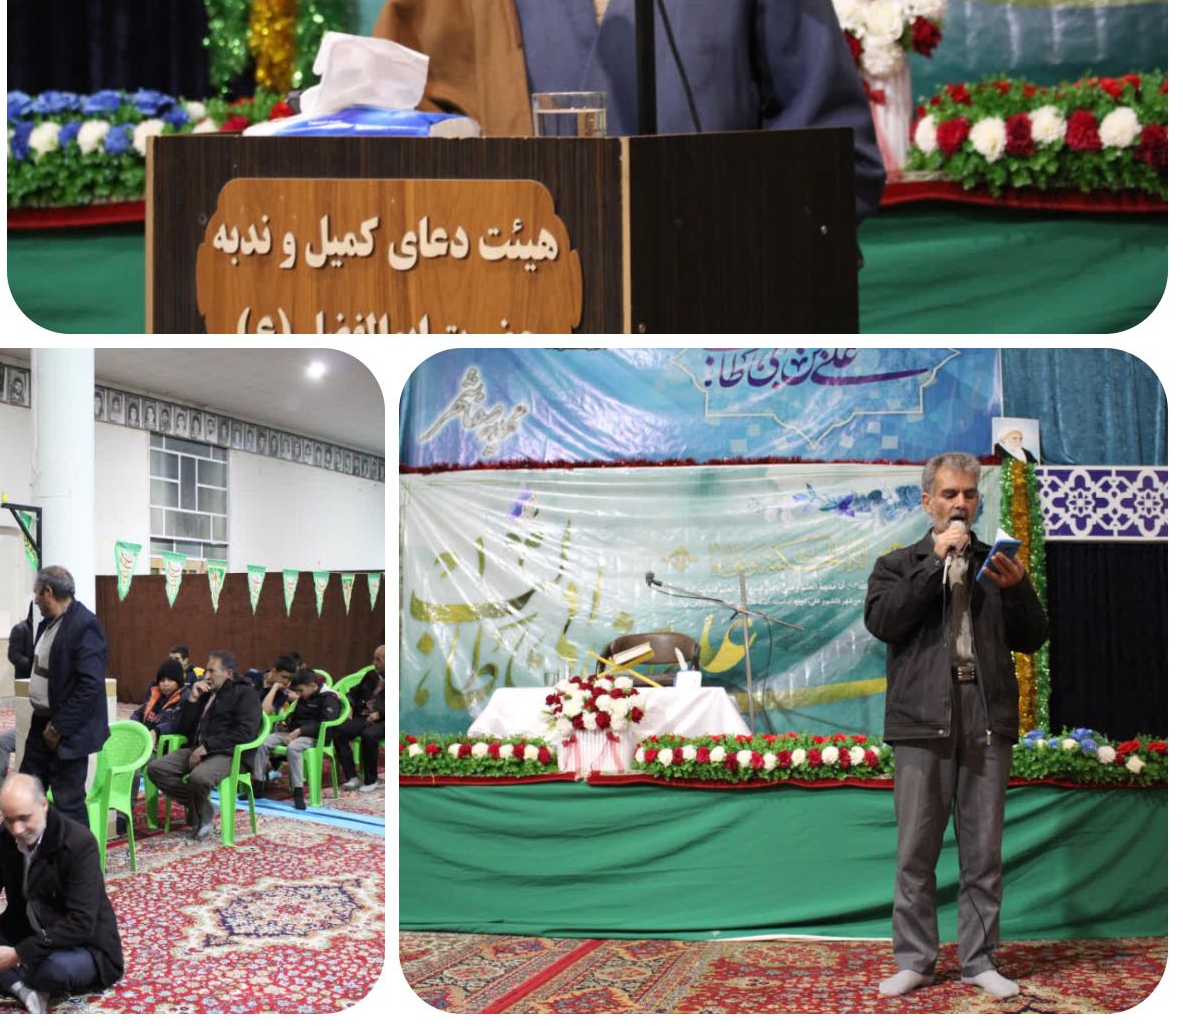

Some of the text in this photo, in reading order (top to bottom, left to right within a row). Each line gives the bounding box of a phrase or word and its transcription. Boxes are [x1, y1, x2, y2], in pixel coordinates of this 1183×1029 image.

[212, 214, 560, 273] هیئت دعای کمیل و ندبه
